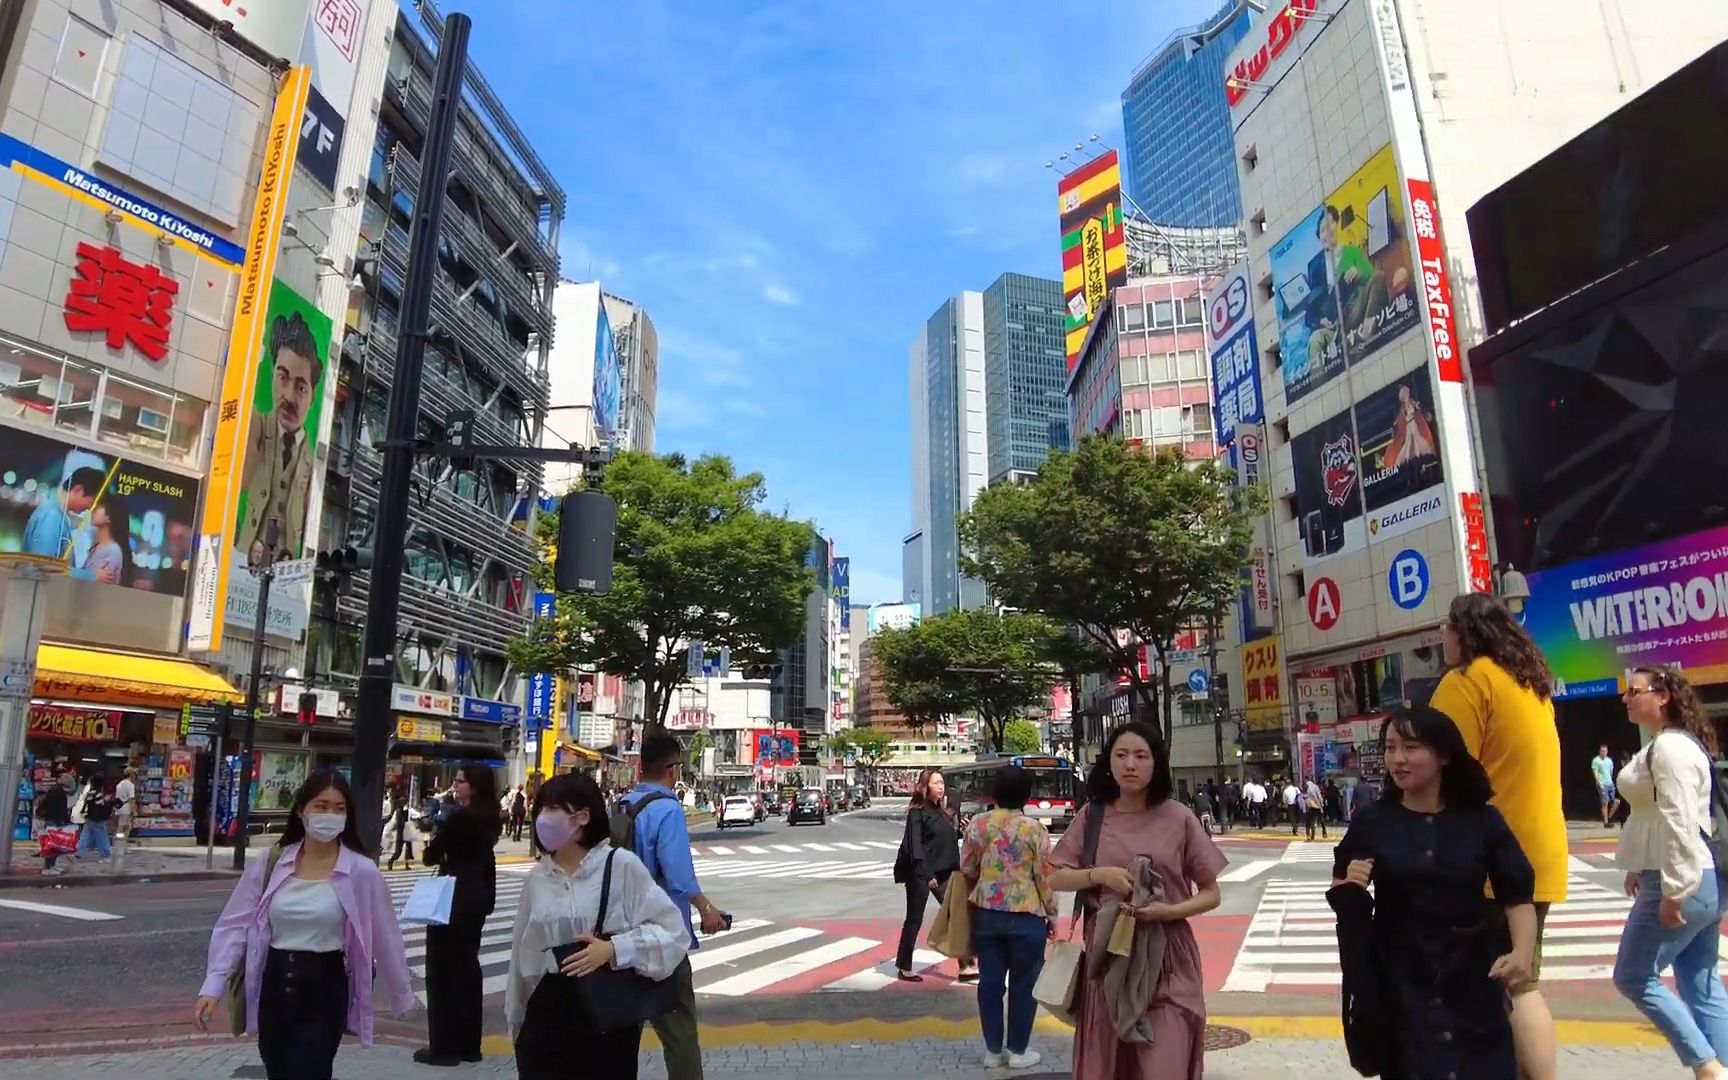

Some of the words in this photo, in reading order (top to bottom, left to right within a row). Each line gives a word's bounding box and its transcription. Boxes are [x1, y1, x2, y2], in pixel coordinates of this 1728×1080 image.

[300, 106, 335, 154] 7F
[64, 169, 158, 223] Matsumoto
[159, 213, 214, 248] KiYoshi
[240, 196, 271, 315] Matsumoto
[264, 123, 286, 193] KiYoshi
[64, 241, 180, 362] 薬
[1211, 277, 1247, 337] OS
[1422, 257, 1453, 361] TaxFree
[1216, 331, 1252, 394] 調剤
[1220, 376, 1257, 437] 薬局
[118, 473, 151, 489] HAPPY
[152, 482, 183, 498] SLASH
[1363, 464, 1400, 488] GALLERIA
[1381, 497, 1441, 528] GALLERIA
[1314, 582, 1335, 624] A
[1395, 556, 1422, 603] B
[1245, 644, 1277, 675] クスリ
[1111, 694, 1130, 717] LUSH
[1247, 673, 1280, 705] 調剤
